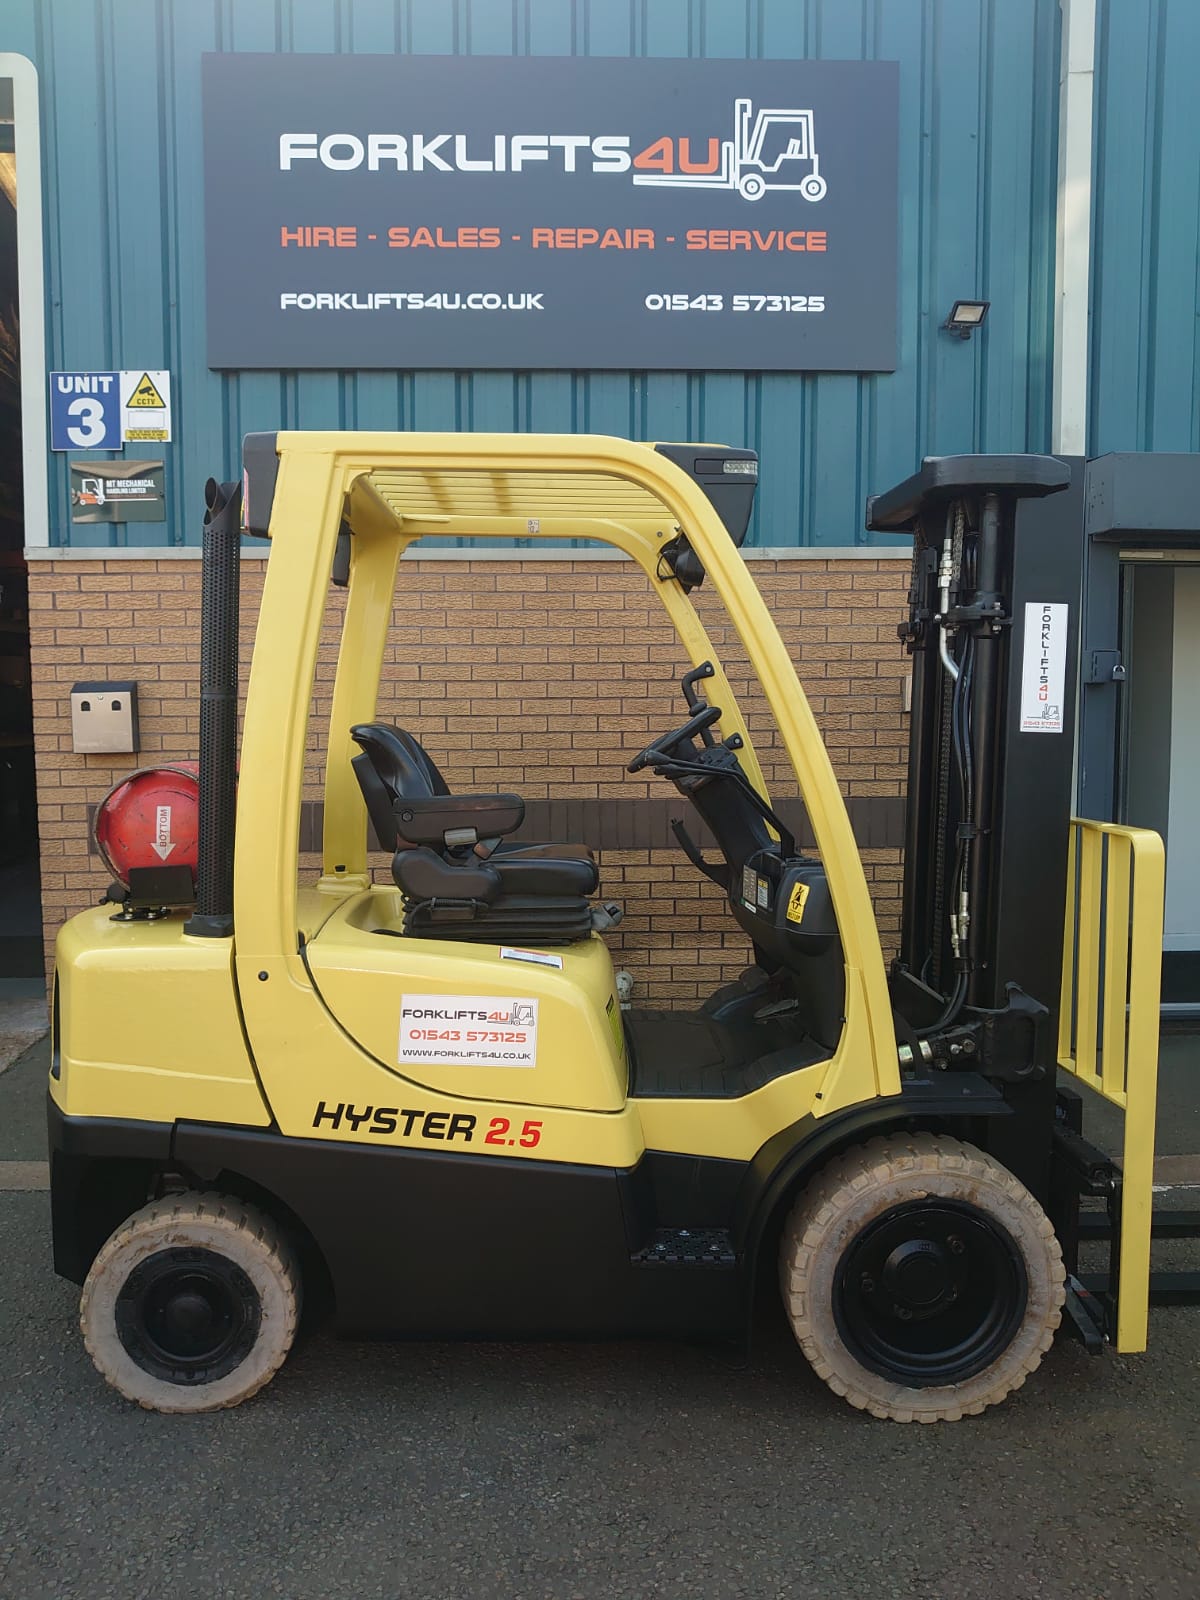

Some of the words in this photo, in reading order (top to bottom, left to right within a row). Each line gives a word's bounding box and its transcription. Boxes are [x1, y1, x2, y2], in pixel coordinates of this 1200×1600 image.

[280, 134, 718, 173] FORKLIFTS4U
[281, 227, 357, 247] HIRE
[388, 227, 501, 248] SALES
[532, 228, 655, 249] REPAIR
[686, 230, 827, 251] SERVICE
[281, 293, 544, 310] FORKLIFTS4U.CO.UK
[645, 295, 724, 311] 01543
[733, 295, 825, 312] 573125
[58, 376, 113, 394] UNIT
[67, 398, 107, 447] 3
[105, 480, 118, 488] MT
[118, 479, 156, 488] MECHANICAL
[159, 808, 168, 847] BOTTOM
[402, 1008, 510, 1022] FORKLIFTS4U
[409, 1030, 461, 1041] 01543
[466, 1031, 527, 1043] 573125
[402, 1049, 531, 1060] WWW.FORKLIFTS4U.CO.UK
[312, 1101, 477, 1142] HYSTER
[484, 1117, 543, 1148] 2.5
